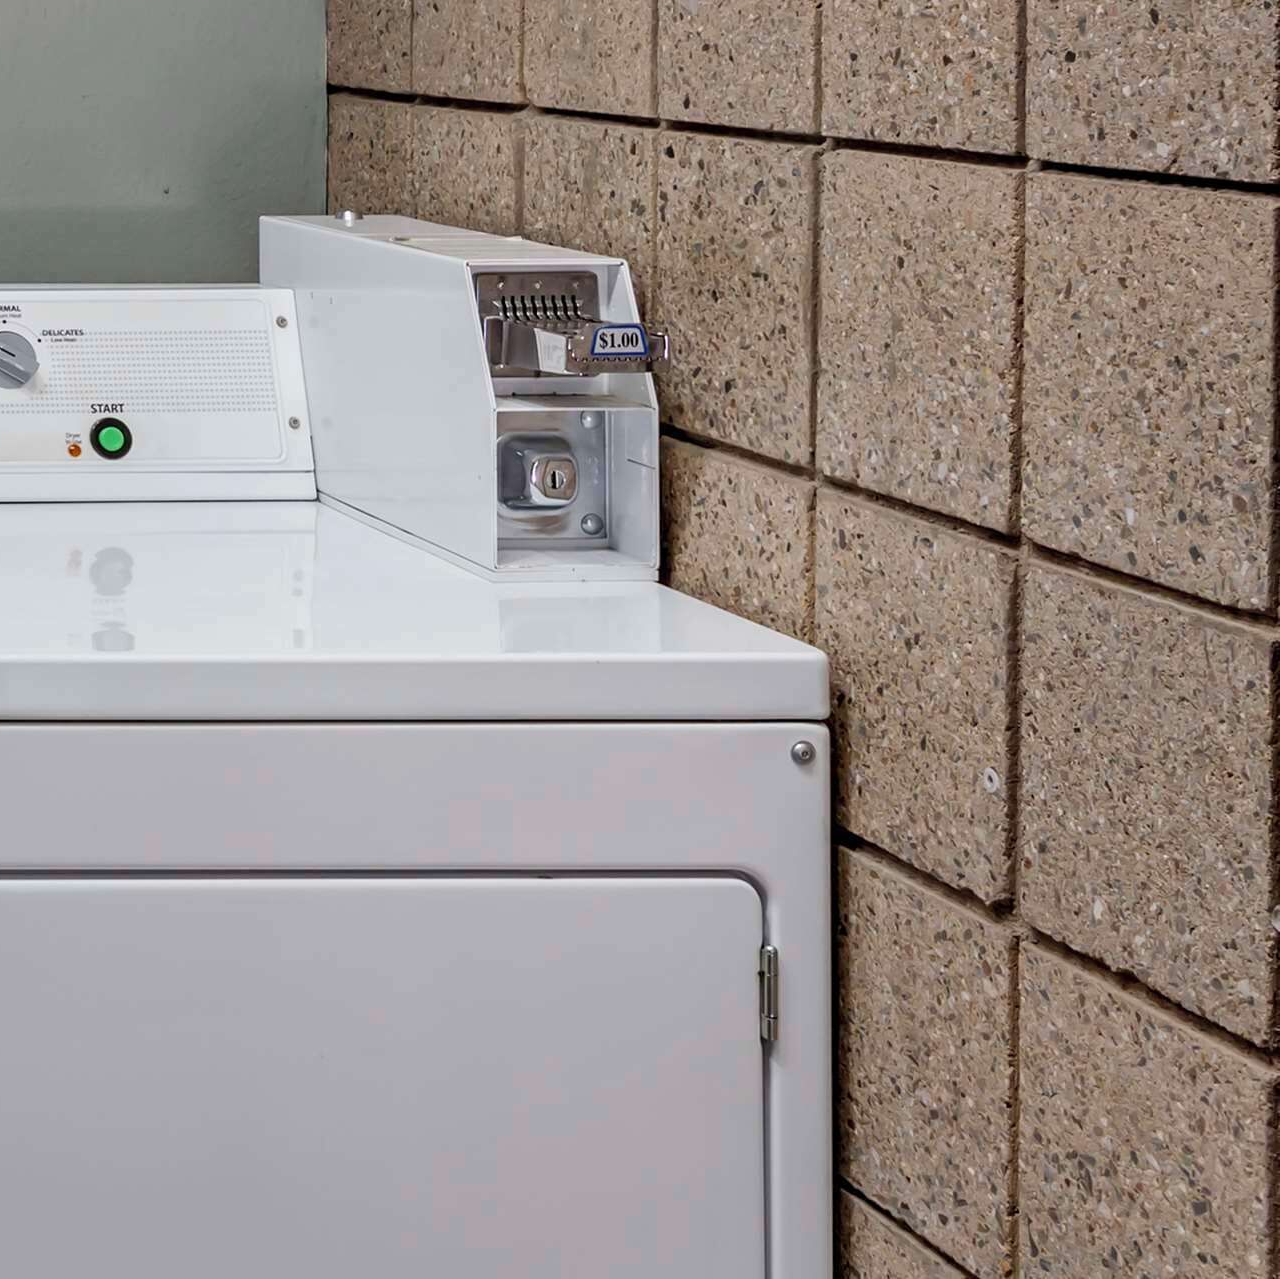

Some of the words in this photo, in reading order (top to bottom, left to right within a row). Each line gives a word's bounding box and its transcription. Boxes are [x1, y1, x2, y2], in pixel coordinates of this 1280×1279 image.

[42, 329, 84, 337] DELICATES
[599, 332, 638, 349] $1.00
[91, 403, 124, 414] START
